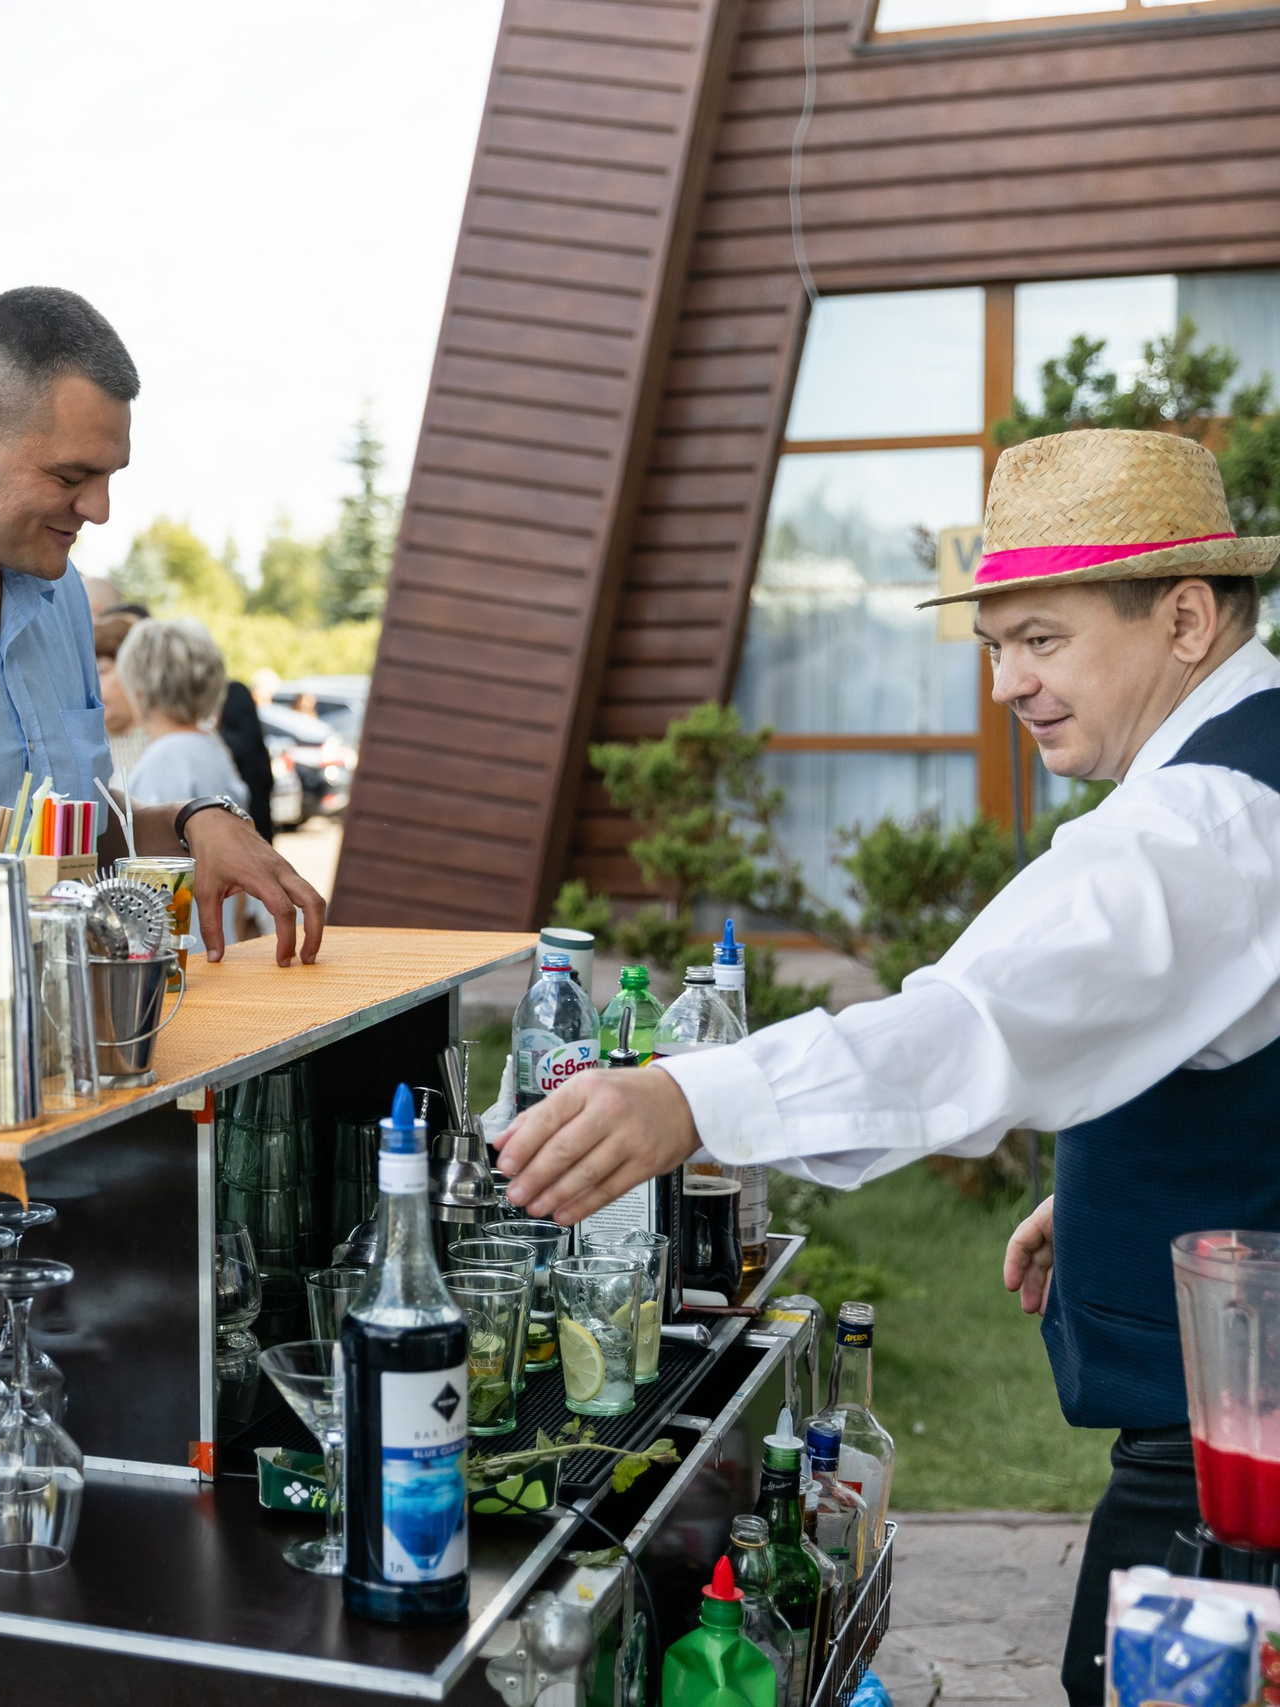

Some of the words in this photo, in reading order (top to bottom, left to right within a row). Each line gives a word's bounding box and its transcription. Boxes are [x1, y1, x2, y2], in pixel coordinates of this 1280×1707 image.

[843, 1333, 869, 1342] APEROL
[414, 1430, 438, 1440] BAR
[412, 1449, 437, 1458] BLUE
